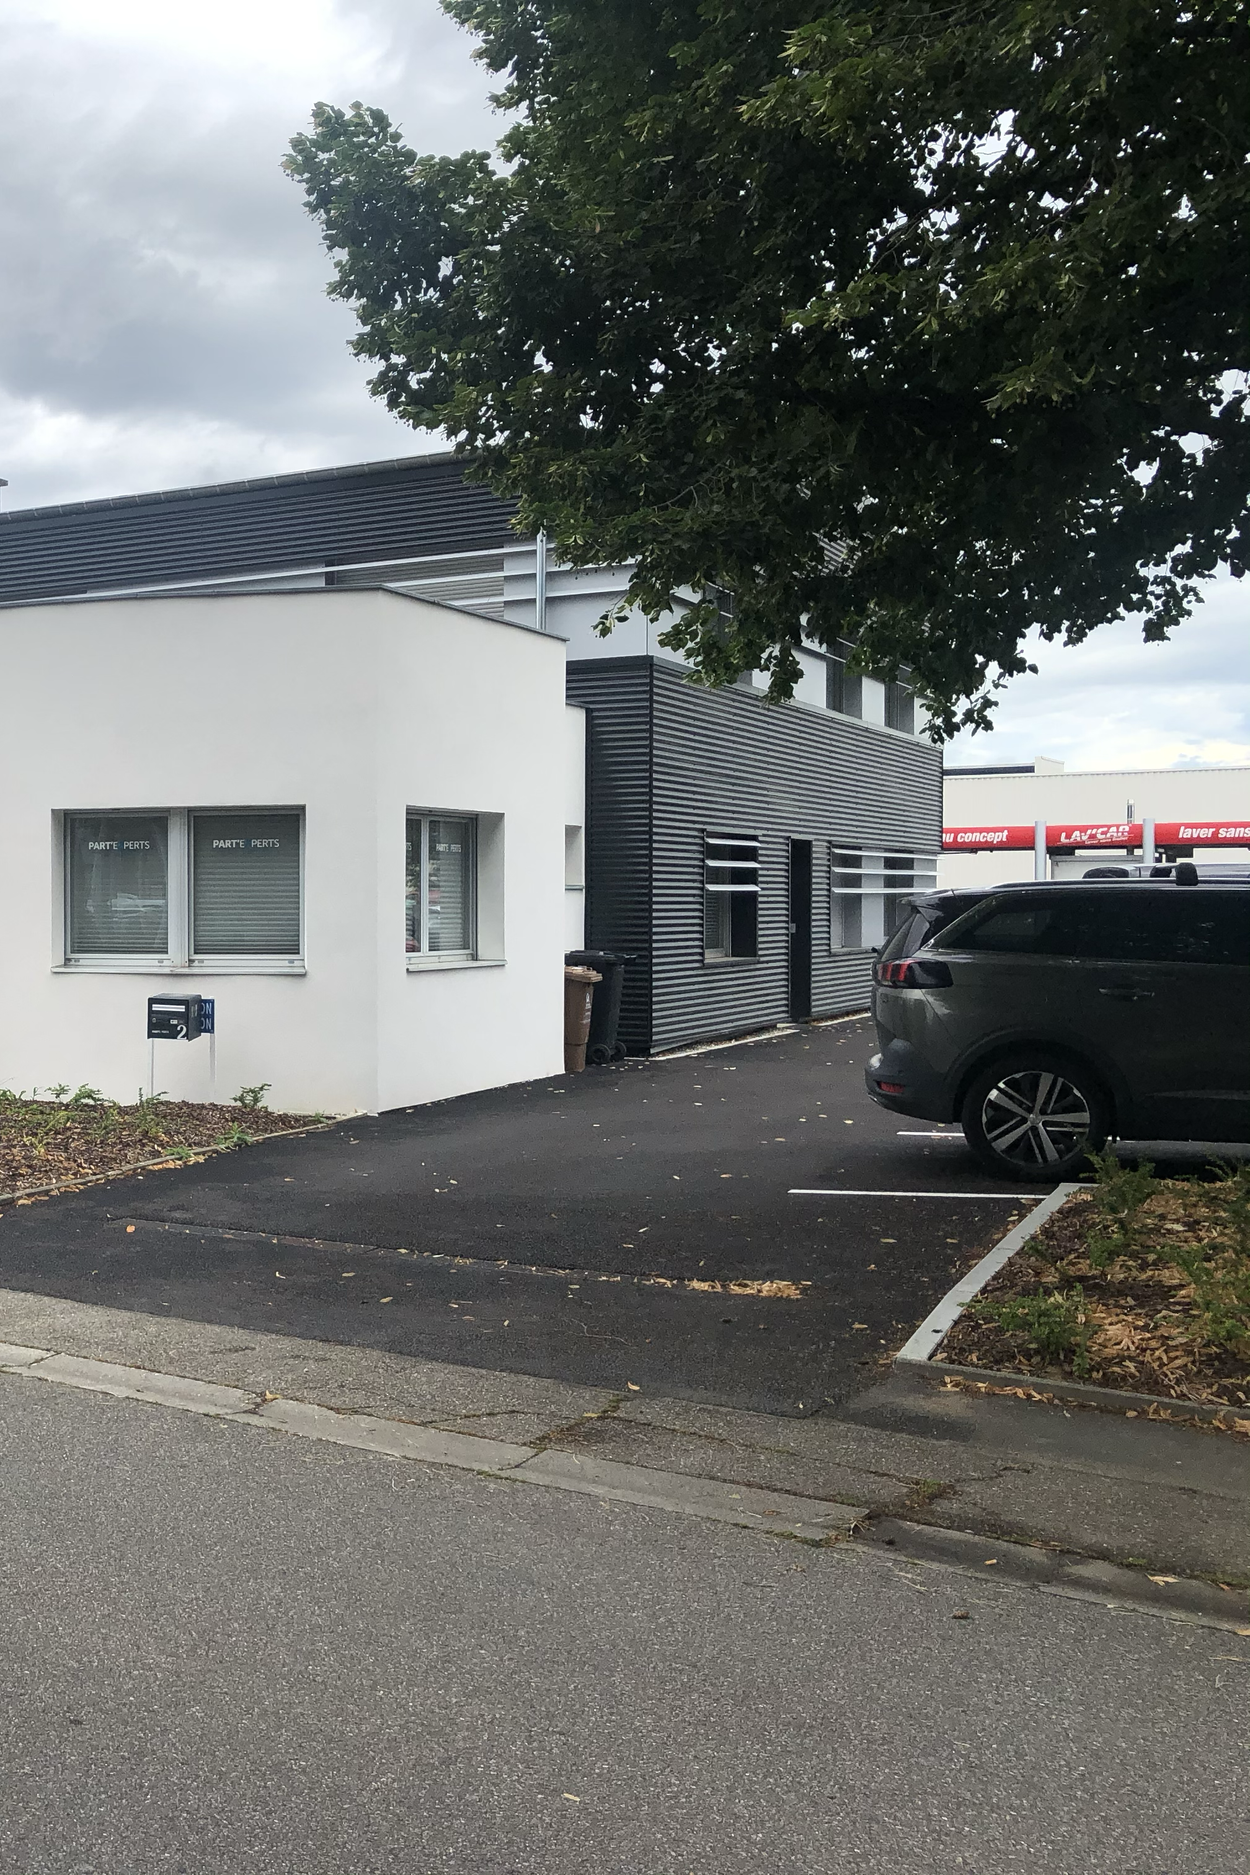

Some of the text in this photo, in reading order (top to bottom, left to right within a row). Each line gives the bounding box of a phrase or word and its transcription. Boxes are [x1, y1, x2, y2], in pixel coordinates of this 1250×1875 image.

[957, 829, 1009, 844] concept
[1178, 825, 1216, 839] laver
[176, 1024, 187, 1040] 2
